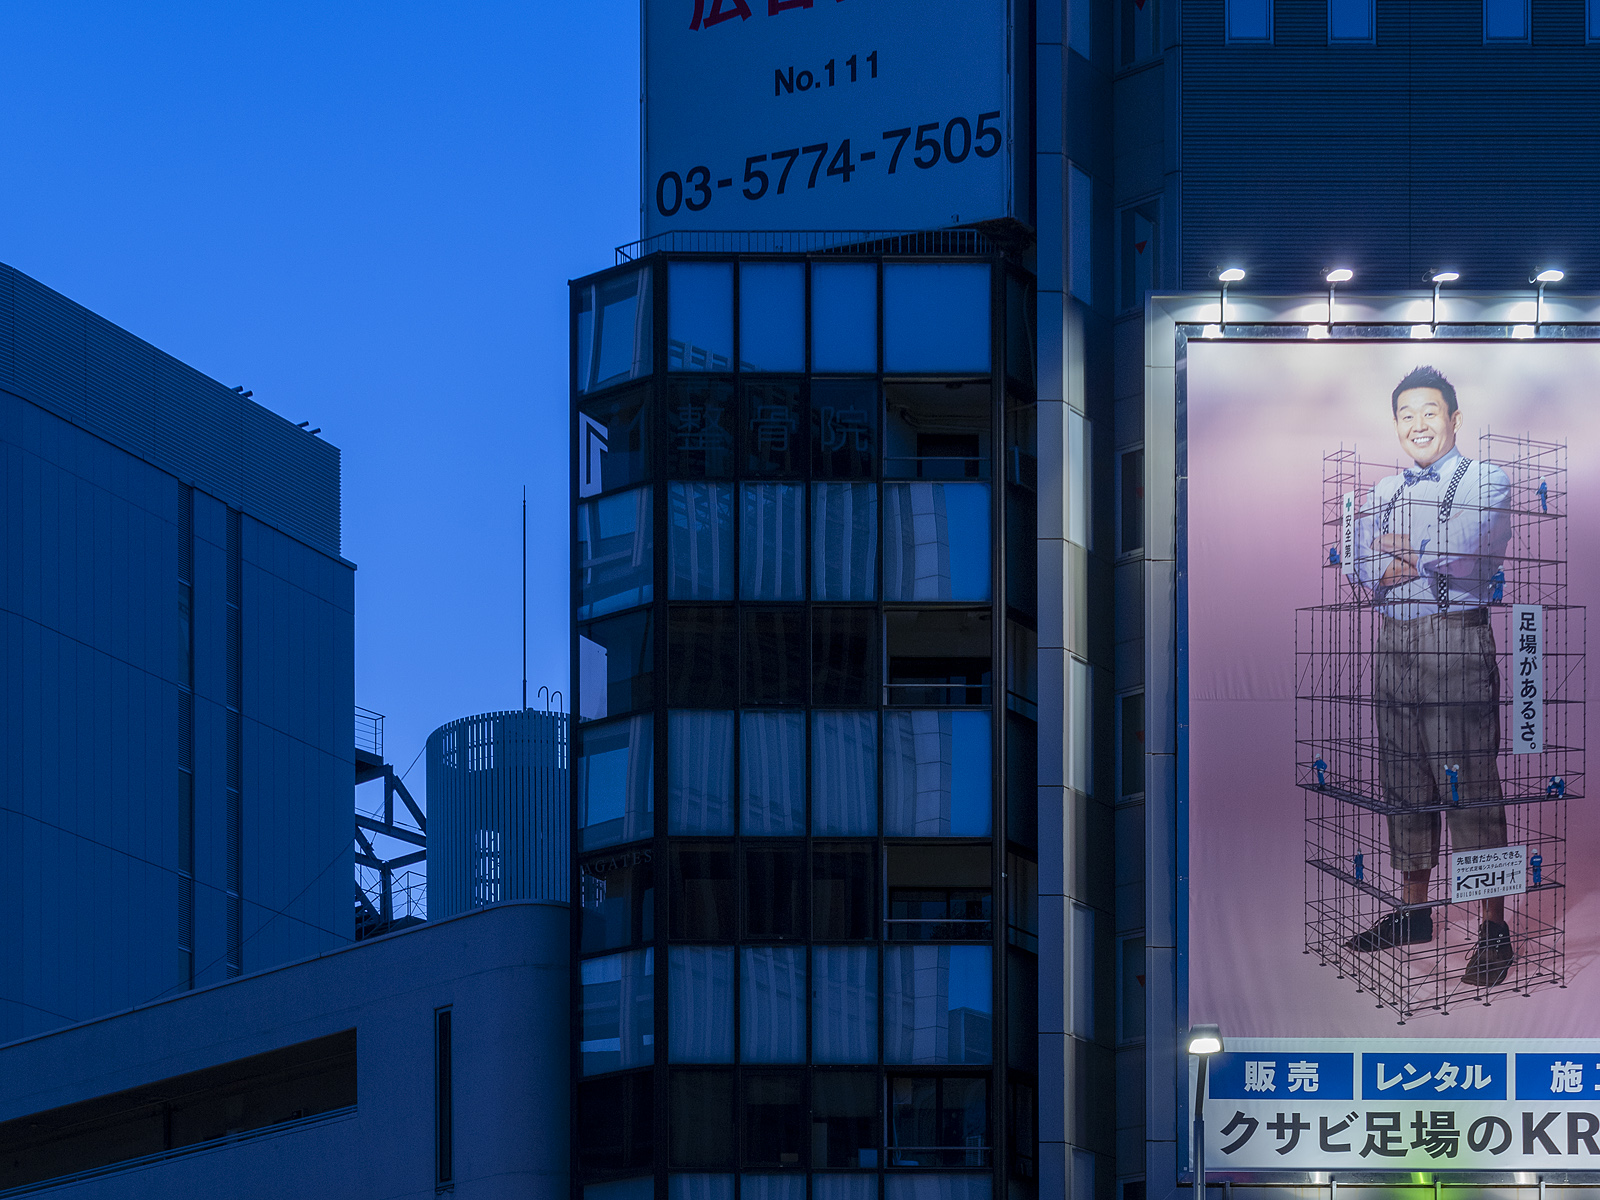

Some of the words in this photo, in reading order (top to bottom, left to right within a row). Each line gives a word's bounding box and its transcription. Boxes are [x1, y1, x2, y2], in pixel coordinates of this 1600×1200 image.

[774, 50, 879, 96] No.111
[655, 110, 1003, 217] 03-5774-7505
[675, 403, 870, 453] 整骨院
[1519, 612, 1537, 750] 足場があるさ。
[1456, 890, 1481, 898] BUILDING
[1483, 884, 1522, 895] FRONT-RUNNER
[1244, 1060, 1319, 1093] 販売
[1376, 1061, 1491, 1091] レンタル
[1550, 1061, 1600, 1093] 施
[1220, 1110, 1600, 1159] クサビ足場のKR
